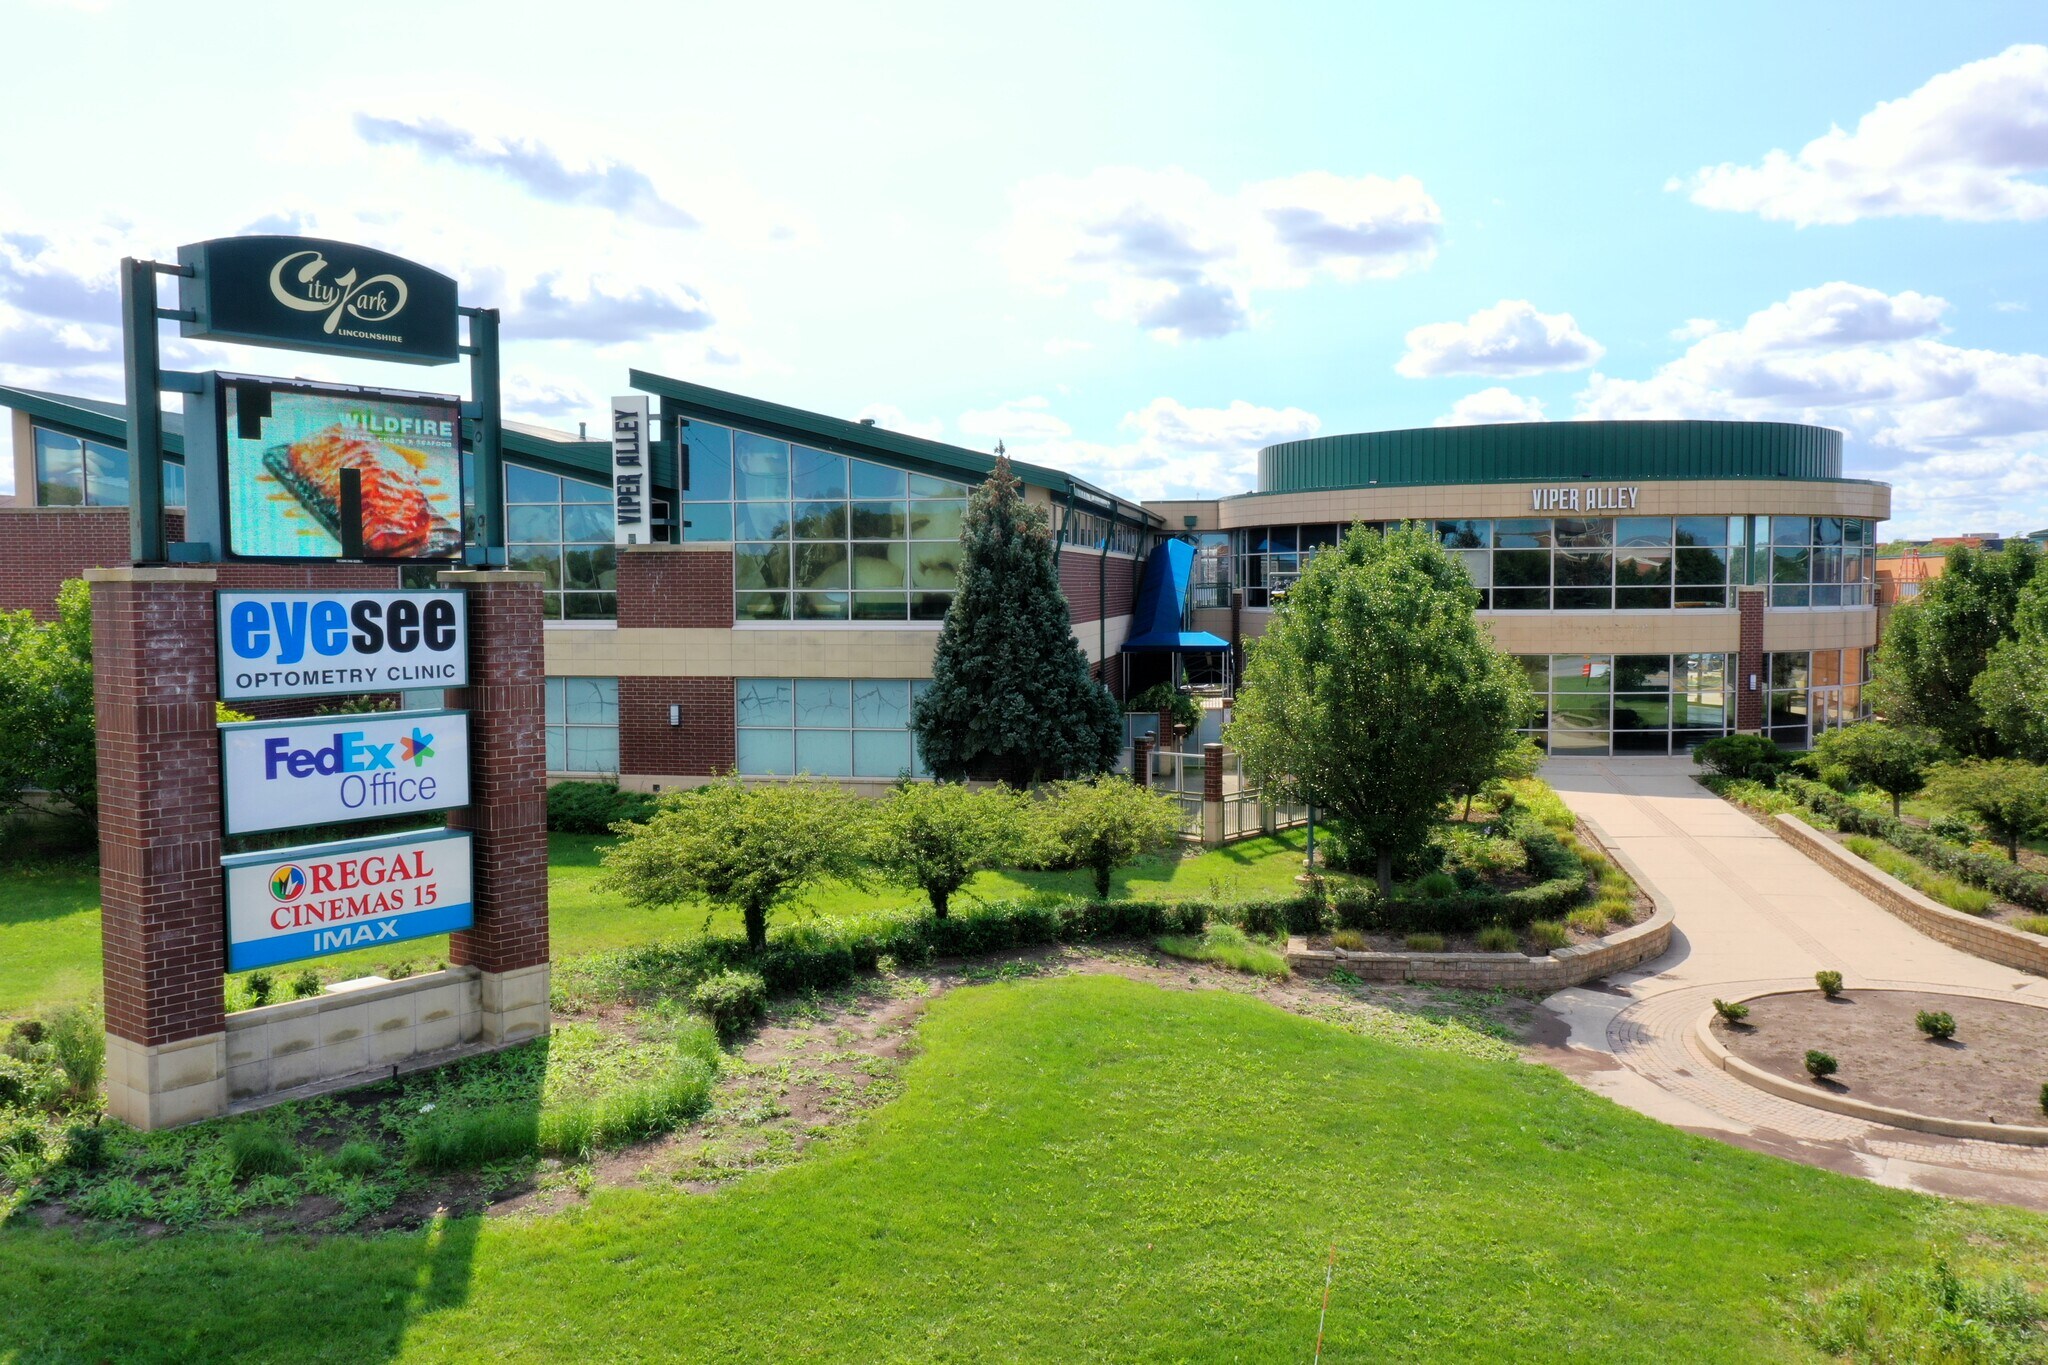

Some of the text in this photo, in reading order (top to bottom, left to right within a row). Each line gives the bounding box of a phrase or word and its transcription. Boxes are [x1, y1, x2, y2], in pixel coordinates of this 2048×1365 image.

[270, 251, 408, 334] City Park
[338, 328, 403, 343] LINCOLNSHIRE
[338, 412, 453, 437] WILDFIRE
[615, 409, 643, 526] VIPER ALLEY
[1532, 487, 1638, 512] VIPER ALLEY
[230, 599, 456, 665] eyesee
[236, 664, 456, 689] OPTOMETRY CLINIC
[264, 731, 396, 780] FedEx
[340, 772, 436, 808] Office
[309, 850, 434, 895] REGAL
[270, 883, 438, 930] CINEMAS 15
[313, 919, 399, 952] IMAX
